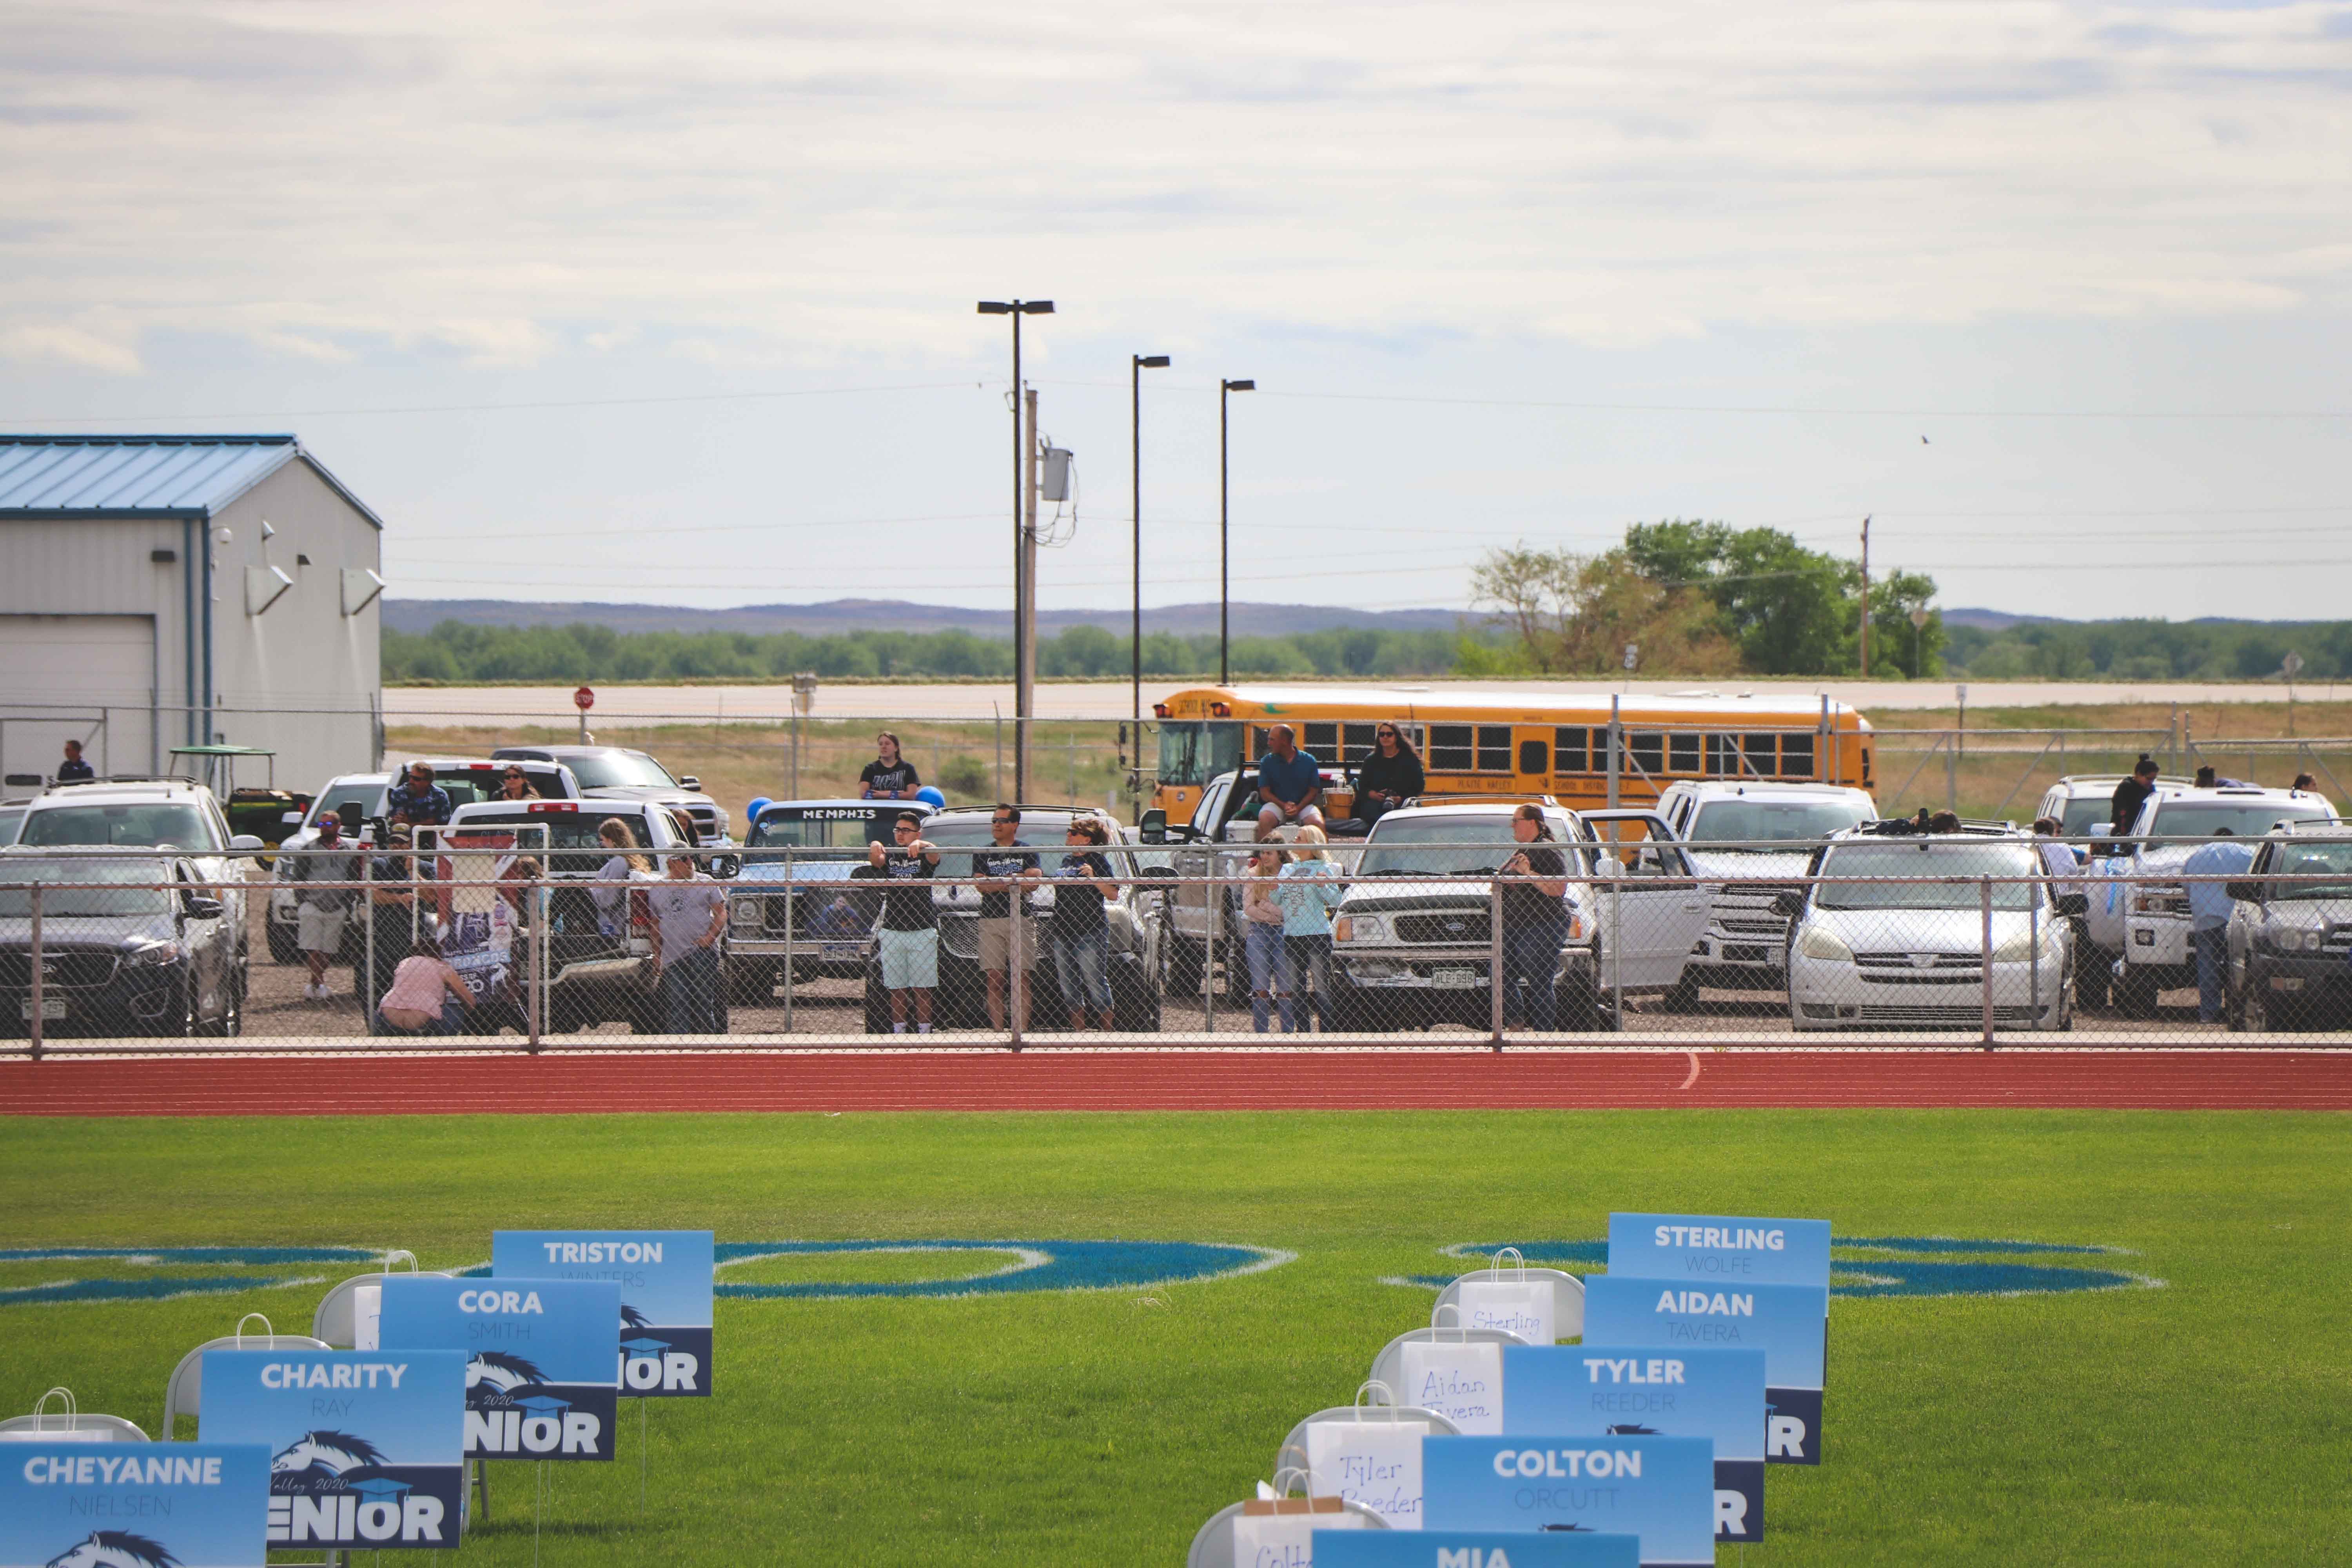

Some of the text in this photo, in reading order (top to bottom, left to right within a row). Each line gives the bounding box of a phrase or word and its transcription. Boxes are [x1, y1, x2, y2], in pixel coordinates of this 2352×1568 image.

[803, 809, 877, 819] MEMPHIS
[1655, 1225, 1784, 1250] STERLING
[544, 1242, 662, 1263] TRISTON
[1684, 1256, 1752, 1274] WOLFE
[458, 1290, 544, 1314] CORA
[1655, 1290, 1753, 1316] AIDAN
[469, 1322, 530, 1339] SMITH
[1472, 1311, 1540, 1336] Sterling
[1667, 1321, 1741, 1341] TAVERA
[261, 1363, 408, 1388] CHARITY
[1583, 1359, 1685, 1383] TYLER
[1423, 1370, 1485, 1398] Aidan
[312, 1398, 354, 1417] RAY
[483, 1394, 514, 1406] 2020
[1591, 1393, 1676, 1412] REEDER
[464, 1410, 601, 1453] NIOR
[24, 1456, 222, 1484] CHEYANNE
[1340, 1456, 1402, 1486] Tyler
[1493, 1450, 1641, 1477] COLTON
[315, 1477, 348, 1490] 2020
[69, 1495, 171, 1516] NIELSEN
[1514, 1488, 1620, 1510] ORCUTT
[267, 1495, 444, 1540] ENIOR
[1437, 1547, 1512, 1568] MIA
